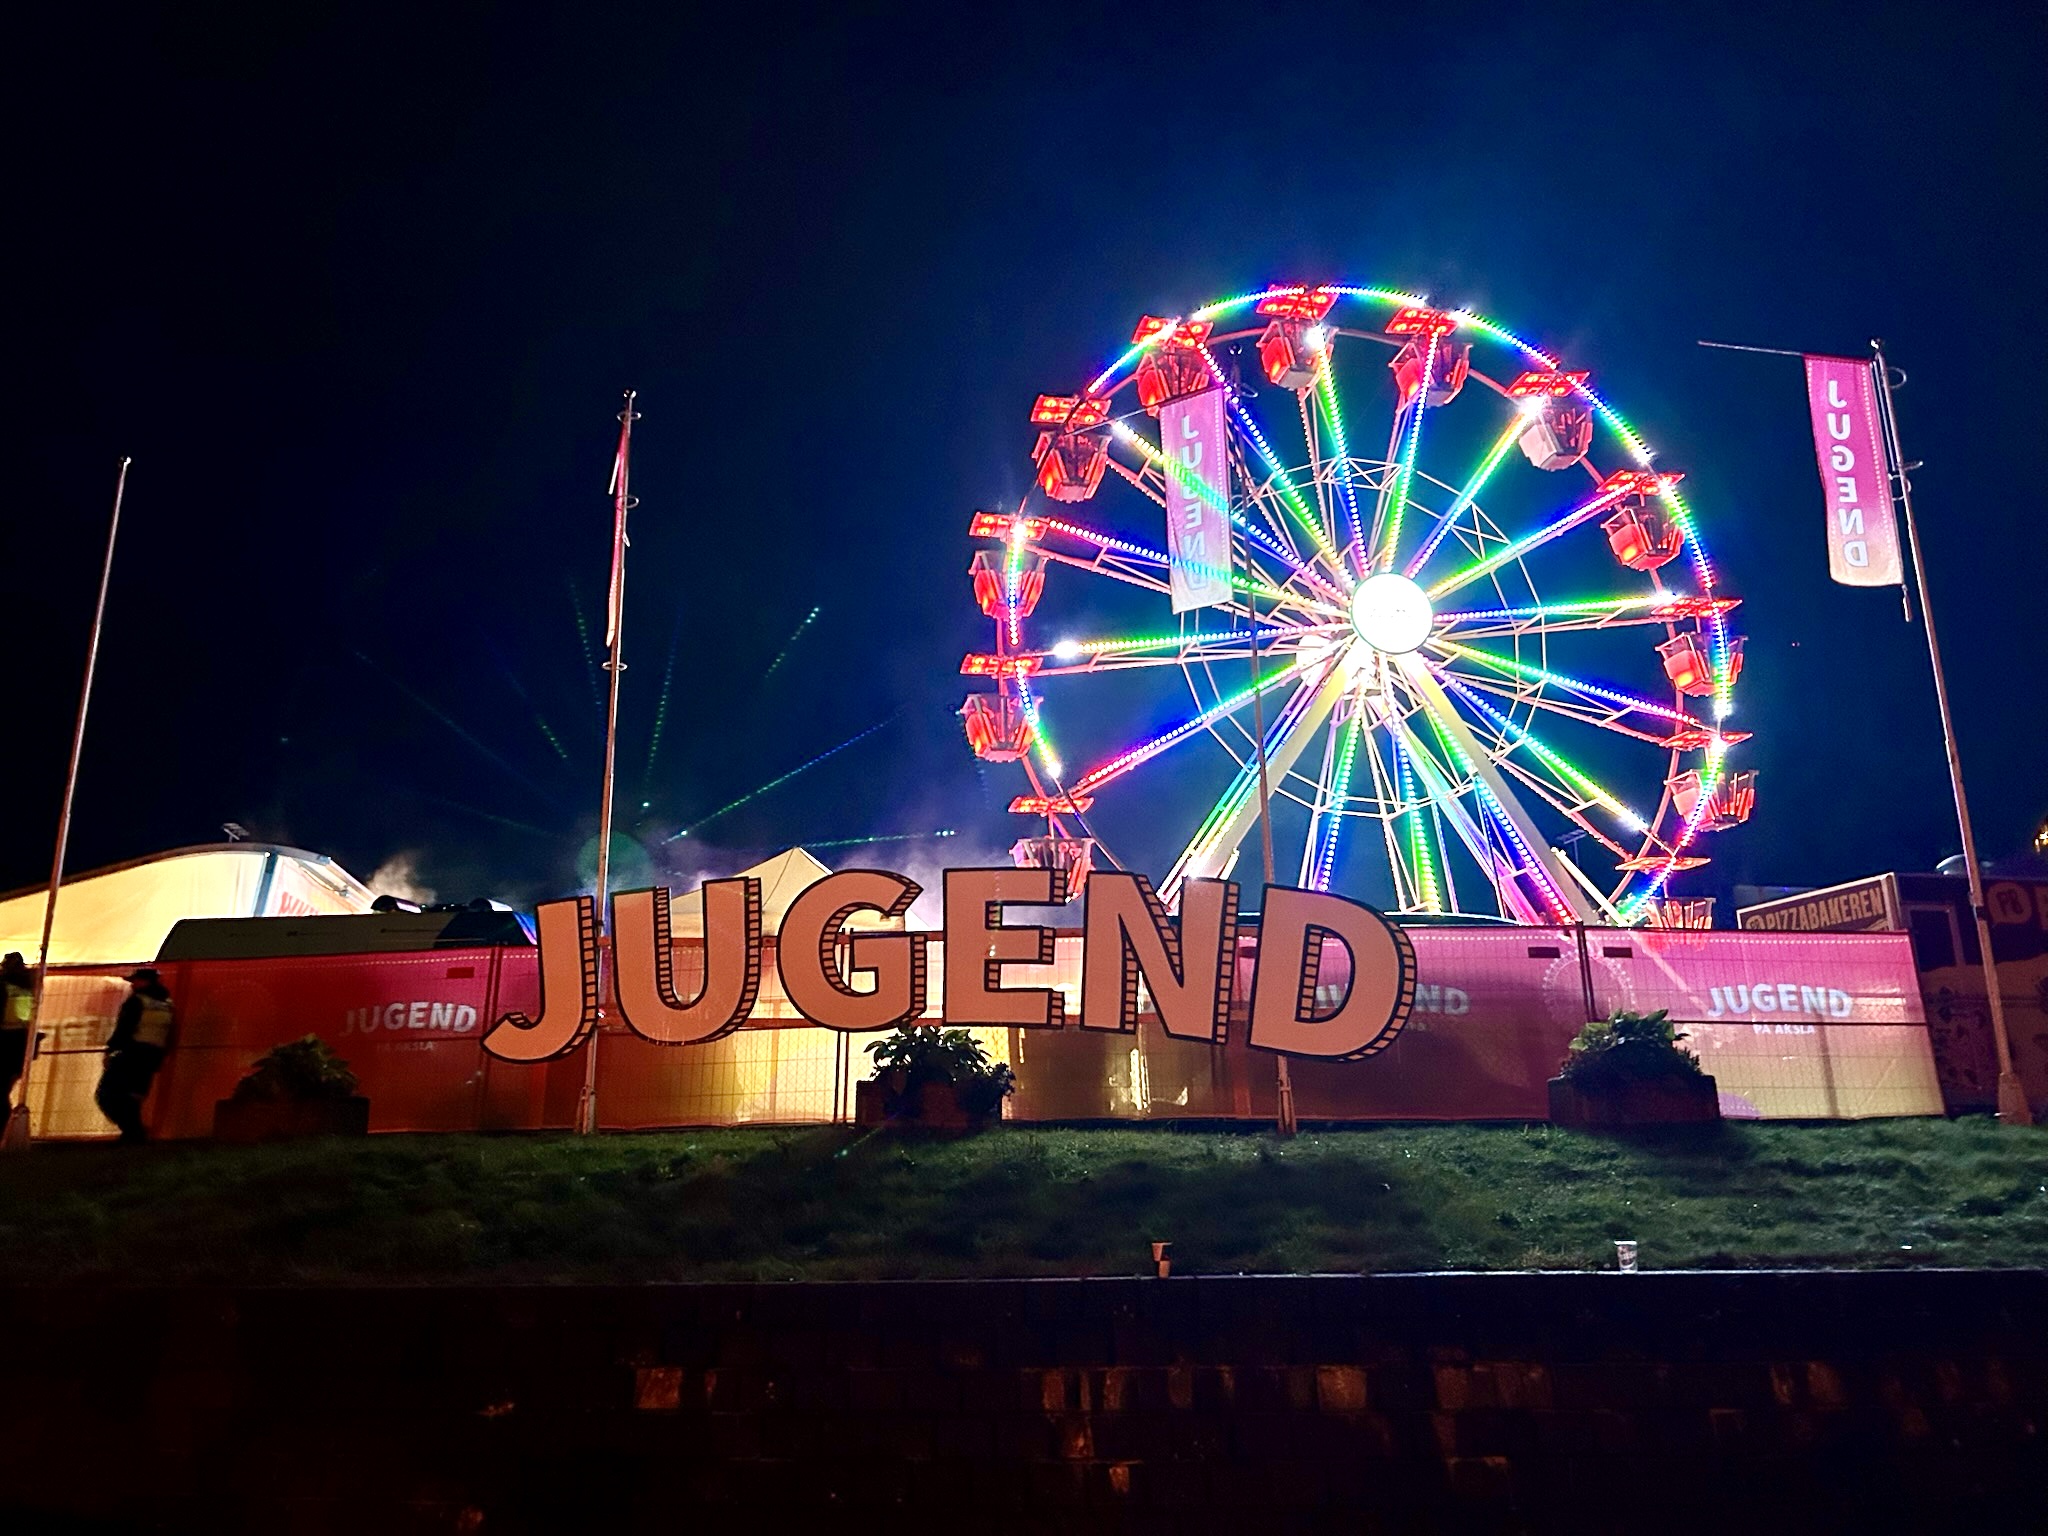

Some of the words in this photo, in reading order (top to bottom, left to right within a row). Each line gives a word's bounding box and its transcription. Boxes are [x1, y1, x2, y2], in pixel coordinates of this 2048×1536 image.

[1765, 886, 1884, 930] PIZZABAKEREN
[482, 867, 1419, 1063] JUGEND
[338, 1001, 477, 1037] JUGEND
[1707, 983, 1853, 1018] JUGEND
